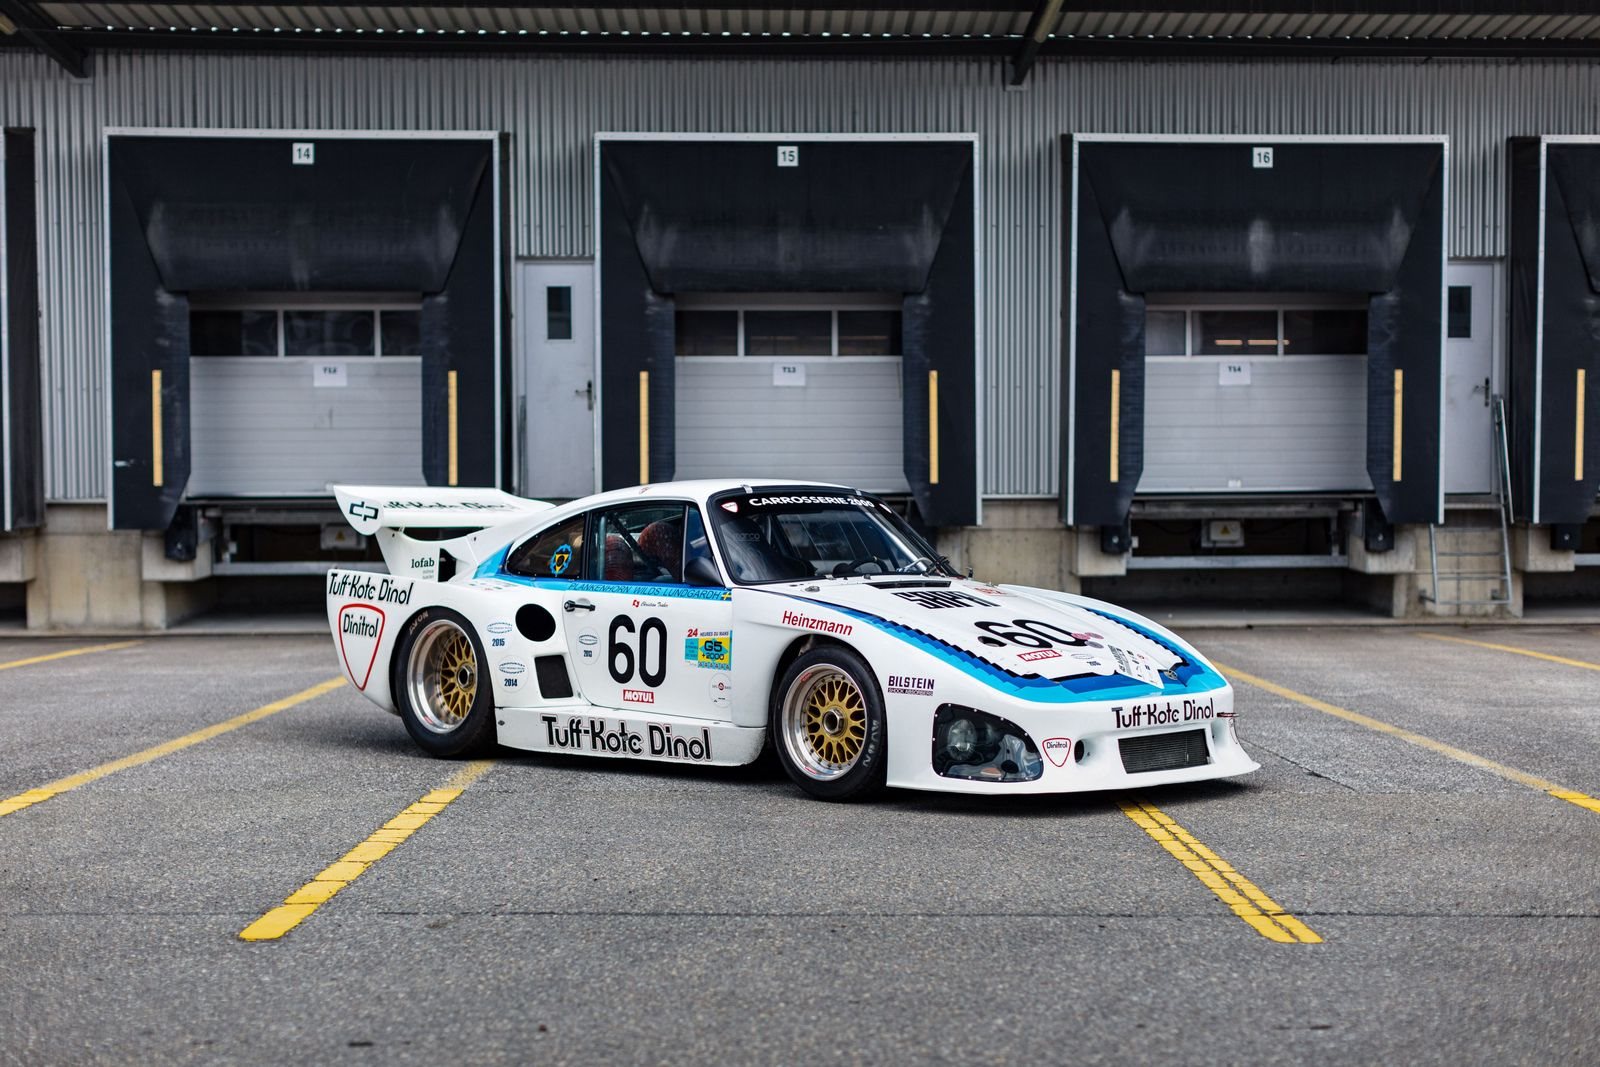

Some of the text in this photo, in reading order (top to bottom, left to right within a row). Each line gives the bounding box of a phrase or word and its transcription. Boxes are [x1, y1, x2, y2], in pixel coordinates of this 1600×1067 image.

[296, 147, 310, 160] 14
[781, 150, 795, 163] 15
[1257, 152, 1270, 164] 16
[749, 496, 848, 506] CARROSSERIE
[378, 578, 414, 604] Dinol
[569, 583, 721, 600] PLANKENHORN WILDS LUNDGARDH
[343, 613, 379, 638] Dinitrol
[782, 610, 853, 636] Heinzmann
[687, 628, 698, 637] 24
[974, 619, 1084, 649] 60
[492, 638, 505, 647] 2015
[704, 640, 722, 652] G5
[608, 614, 668, 688] 60
[1021, 650, 1059, 661] MOTUL
[504, 678, 518, 687] 2014
[888, 675, 934, 690] BILSTEIN
[625, 691, 653, 702] MOTUL
[1183, 698, 1214, 720] Dinol
[649, 724, 711, 760] Dinol
